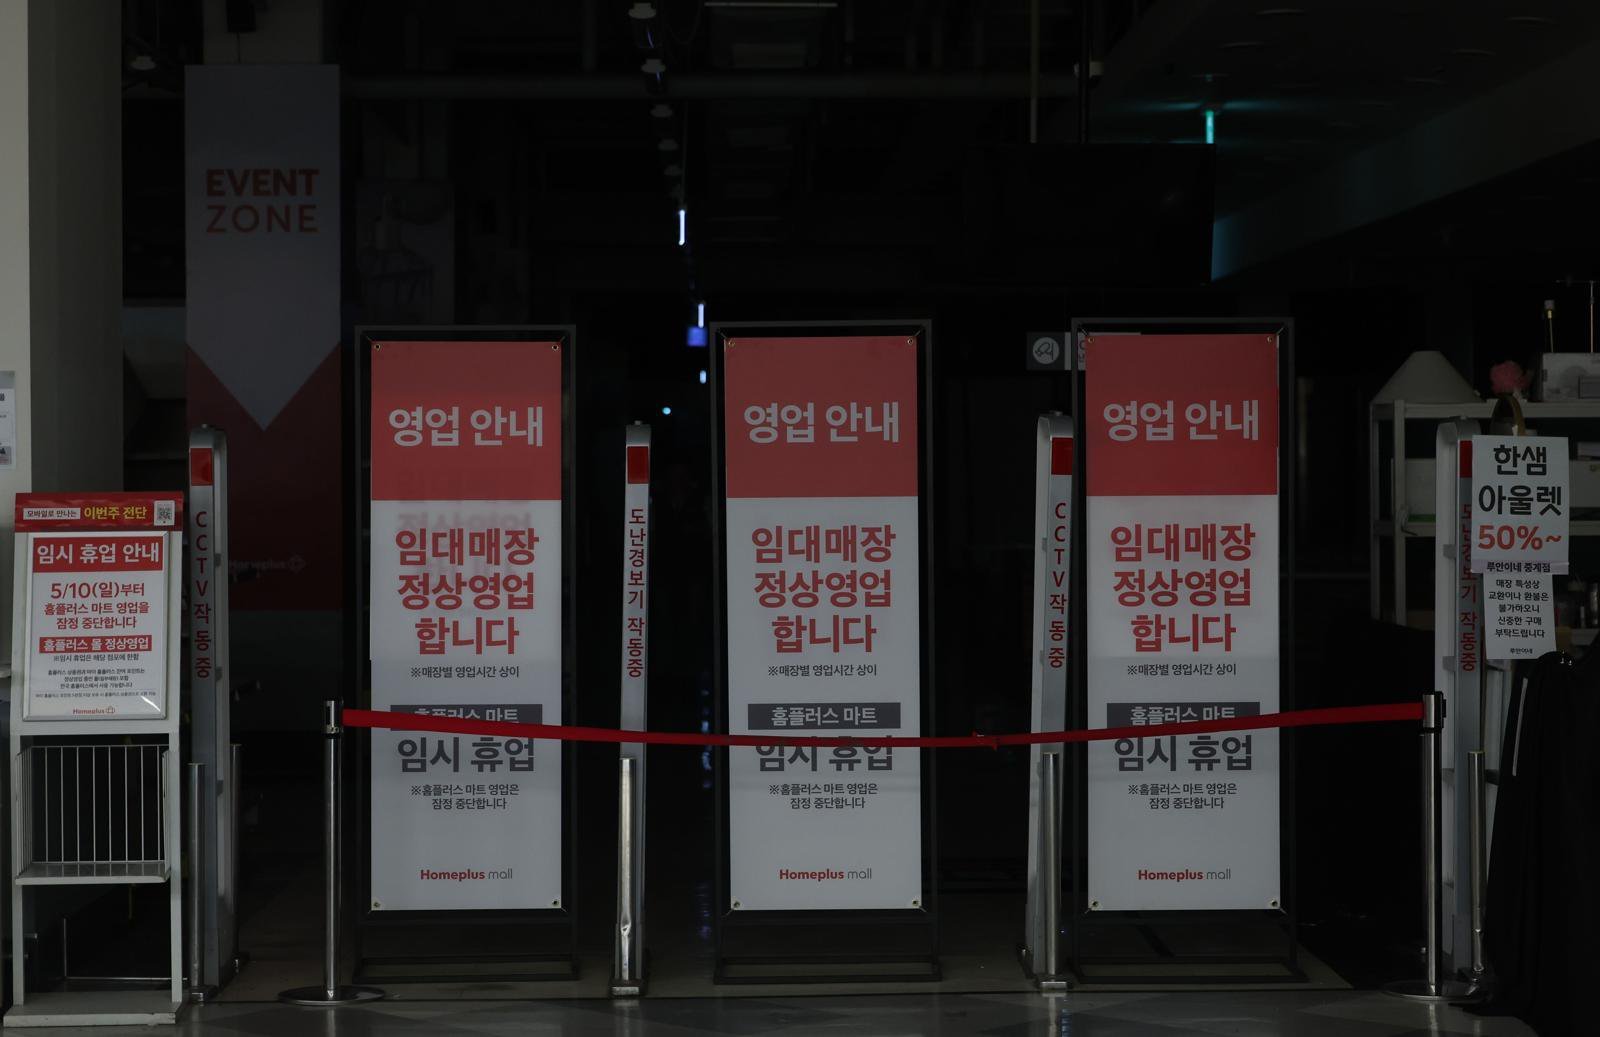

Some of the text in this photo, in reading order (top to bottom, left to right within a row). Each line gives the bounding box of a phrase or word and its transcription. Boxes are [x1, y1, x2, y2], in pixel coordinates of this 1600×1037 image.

[206, 168, 319, 197] EVENT
[206, 205, 318, 233] ZONE
[388, 406, 543, 447] 영업 안내
[743, 401, 899, 444] 영업 안내
[1103, 400, 1259, 442] 영업 안내
[1493, 444, 1547, 476] 한샘
[1478, 485, 1562, 516] 아울렛
[27, 506, 147, 520] 모바일로 만나는 이번주 전단
[395, 528, 540, 566] 임대매장
[751, 524, 896, 564] 임대매장
[1110, 523, 1256, 562] 임대매장
[1478, 525, 1562, 550] 50%~
[37, 542, 159, 565] 임시 휴업 안내
[1524, 562, 1551, 573] 중계점
[50, 582, 145, 600] 5/10(일)부터
[397, 572, 535, 611] 정상영업
[627, 508, 646, 678] 도난경보기 작동중
[754, 569, 891, 609] 정상영업
[1113, 568, 1251, 607] 정상영업
[1496, 579, 1512, 589] 매장
[1488, 591, 1549, 601] 교환이나 환불은
[44, 601, 149, 615] 홈플러스 마트 영업을
[1499, 604, 1540, 613] 불가하오니
[56, 616, 137, 630] 잠정 중단합니다
[1498, 616, 1542, 625] 신중한 구매
[415, 617, 520, 655] 합니다
[772, 614, 877, 653] 합니다
[1130, 613, 1237, 652] 합니다
[1460, 611, 1478, 672] 작동중
[1496, 628, 1545, 638] 부탁드립니다
[43, 637, 149, 652] 홈플러스 몰 정상영업
[455, 666, 496, 678] 영업시간
[499, 666, 520, 678] 상이
[812, 665, 854, 677] 영업시간
[856, 664, 877, 677] 상이
[1172, 664, 1213, 676] 영업시간
[1216, 663, 1237, 676] 상이
[770, 706, 878, 726] 홈플러스 마트
[1130, 705, 1236, 726] 홈플러스 마트
[397, 736, 534, 772] 임시 휴업
[1114, 734, 1252, 772] 임시 휴업
[465, 784, 487, 796] 마트
[488, 783, 520, 796] 영업은
[823, 783, 845, 795] 마트
[846, 783, 878, 795] 영업은
[1183, 783, 1204, 795] 마트
[1206, 783, 1238, 795] 영업은
[431, 797, 507, 810] 잠정 중단합니다
[790, 797, 866, 809] 잠정 중단합니다
[1149, 797, 1225, 809] 잠정 중단합니다
[420, 868, 513, 882] Homeplus mall
[779, 868, 872, 882] Homeplus mall
[1137, 868, 1231, 883] Homeplus mall
